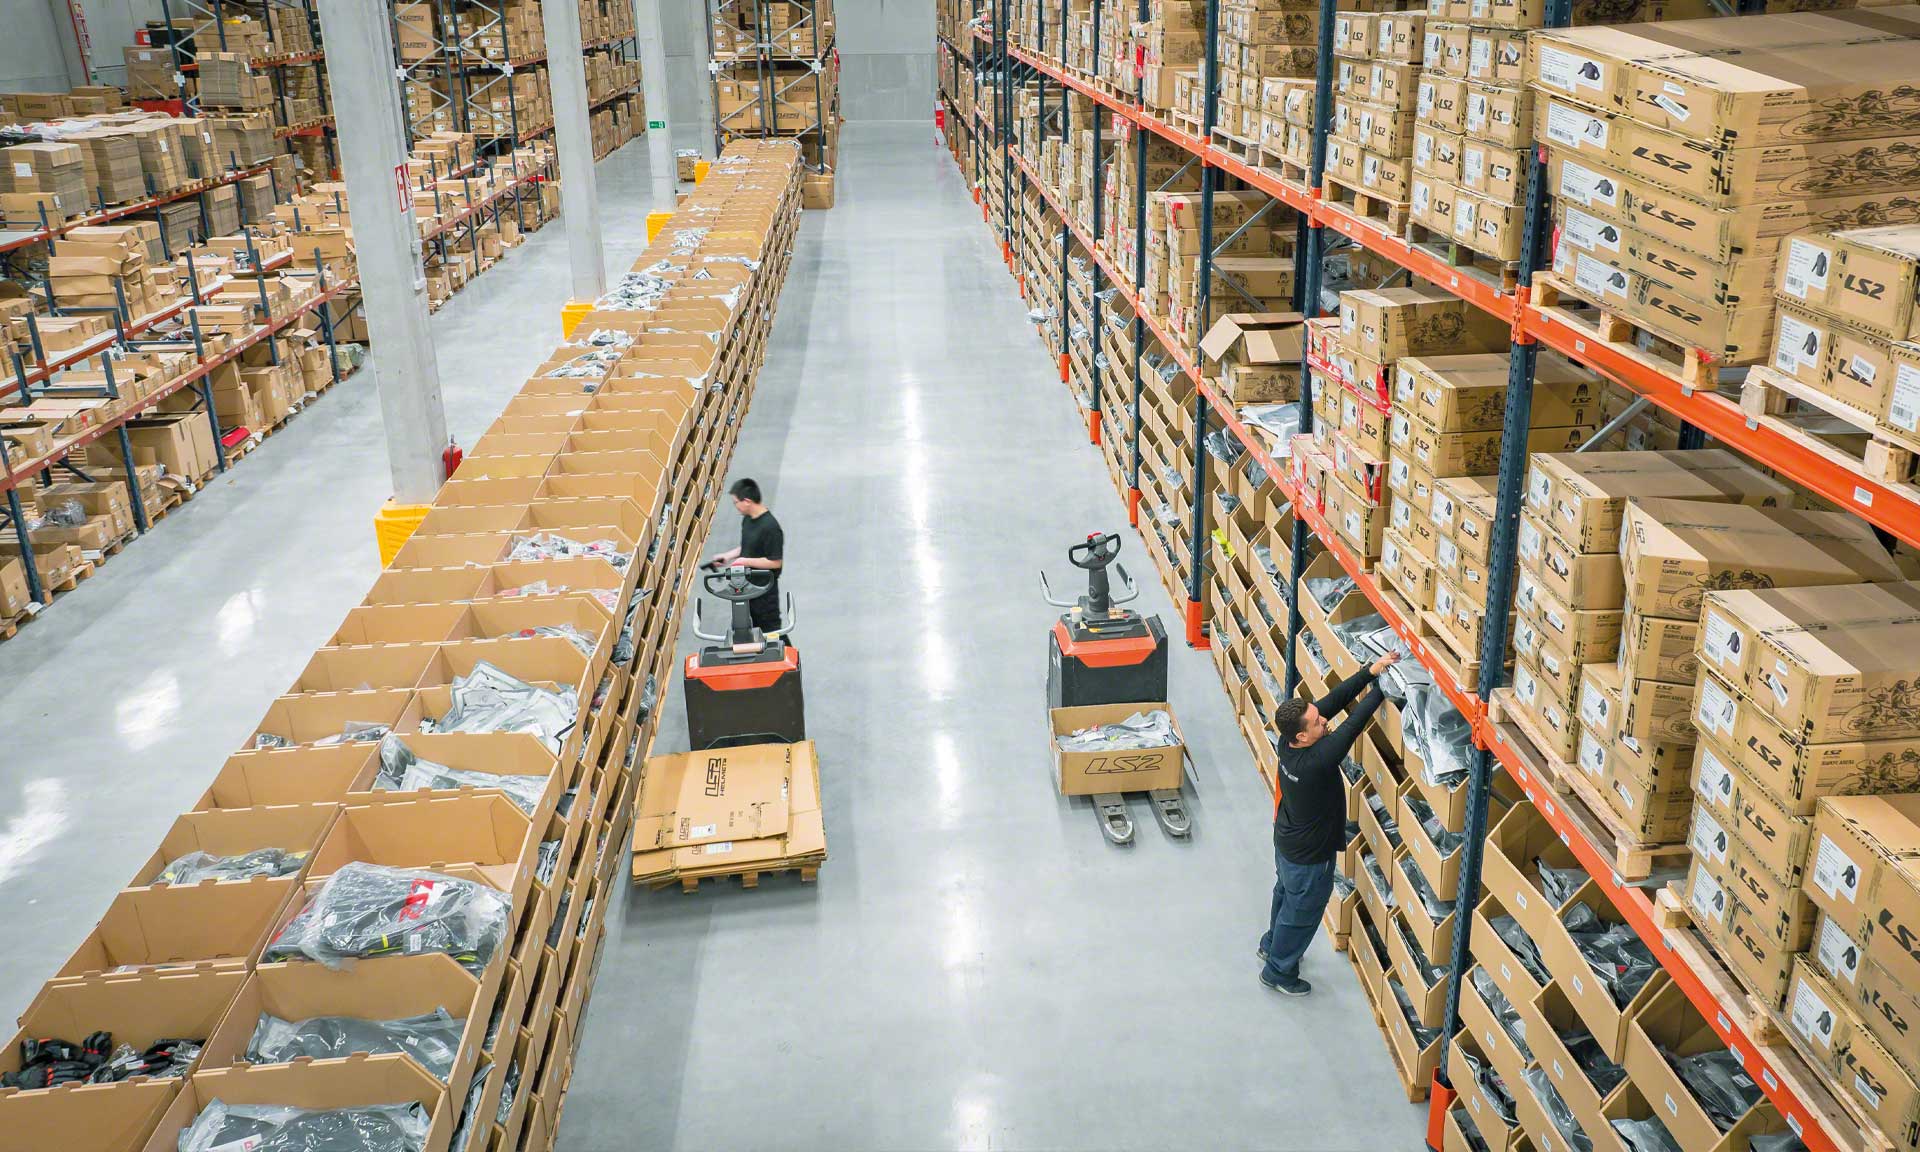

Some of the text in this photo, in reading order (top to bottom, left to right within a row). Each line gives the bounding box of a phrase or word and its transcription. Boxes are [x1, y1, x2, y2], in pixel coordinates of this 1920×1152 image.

[1440, 99, 1453, 110] LS2
[1632, 147, 1692, 175] LS2
[1382, 171, 1395, 182] LS2
[1641, 202, 1697, 231] LS2
[1646, 252, 1698, 280] LS2
[1844, 274, 1885, 300] LS2
[1650, 297, 1702, 326] LS2
[1363, 424, 1377, 439] S2
[1416, 437, 1430, 452] LS2
[1416, 523, 1430, 540] LS2
[1634, 520, 1646, 544] LS2
[1403, 566, 1416, 583] LS2
[1457, 614, 1470, 633] LS2
[1085, 754, 1163, 774] LS2
[1747, 735, 1782, 772] LS2
[705, 758, 721, 797] LS2
[1744, 806, 1776, 842] LS2
[1740, 867, 1769, 905] LS2
[1734, 925, 1765, 964] LS2
[1873, 990, 1908, 1038] LS2
[1846, 1054, 1887, 1102] LS2
